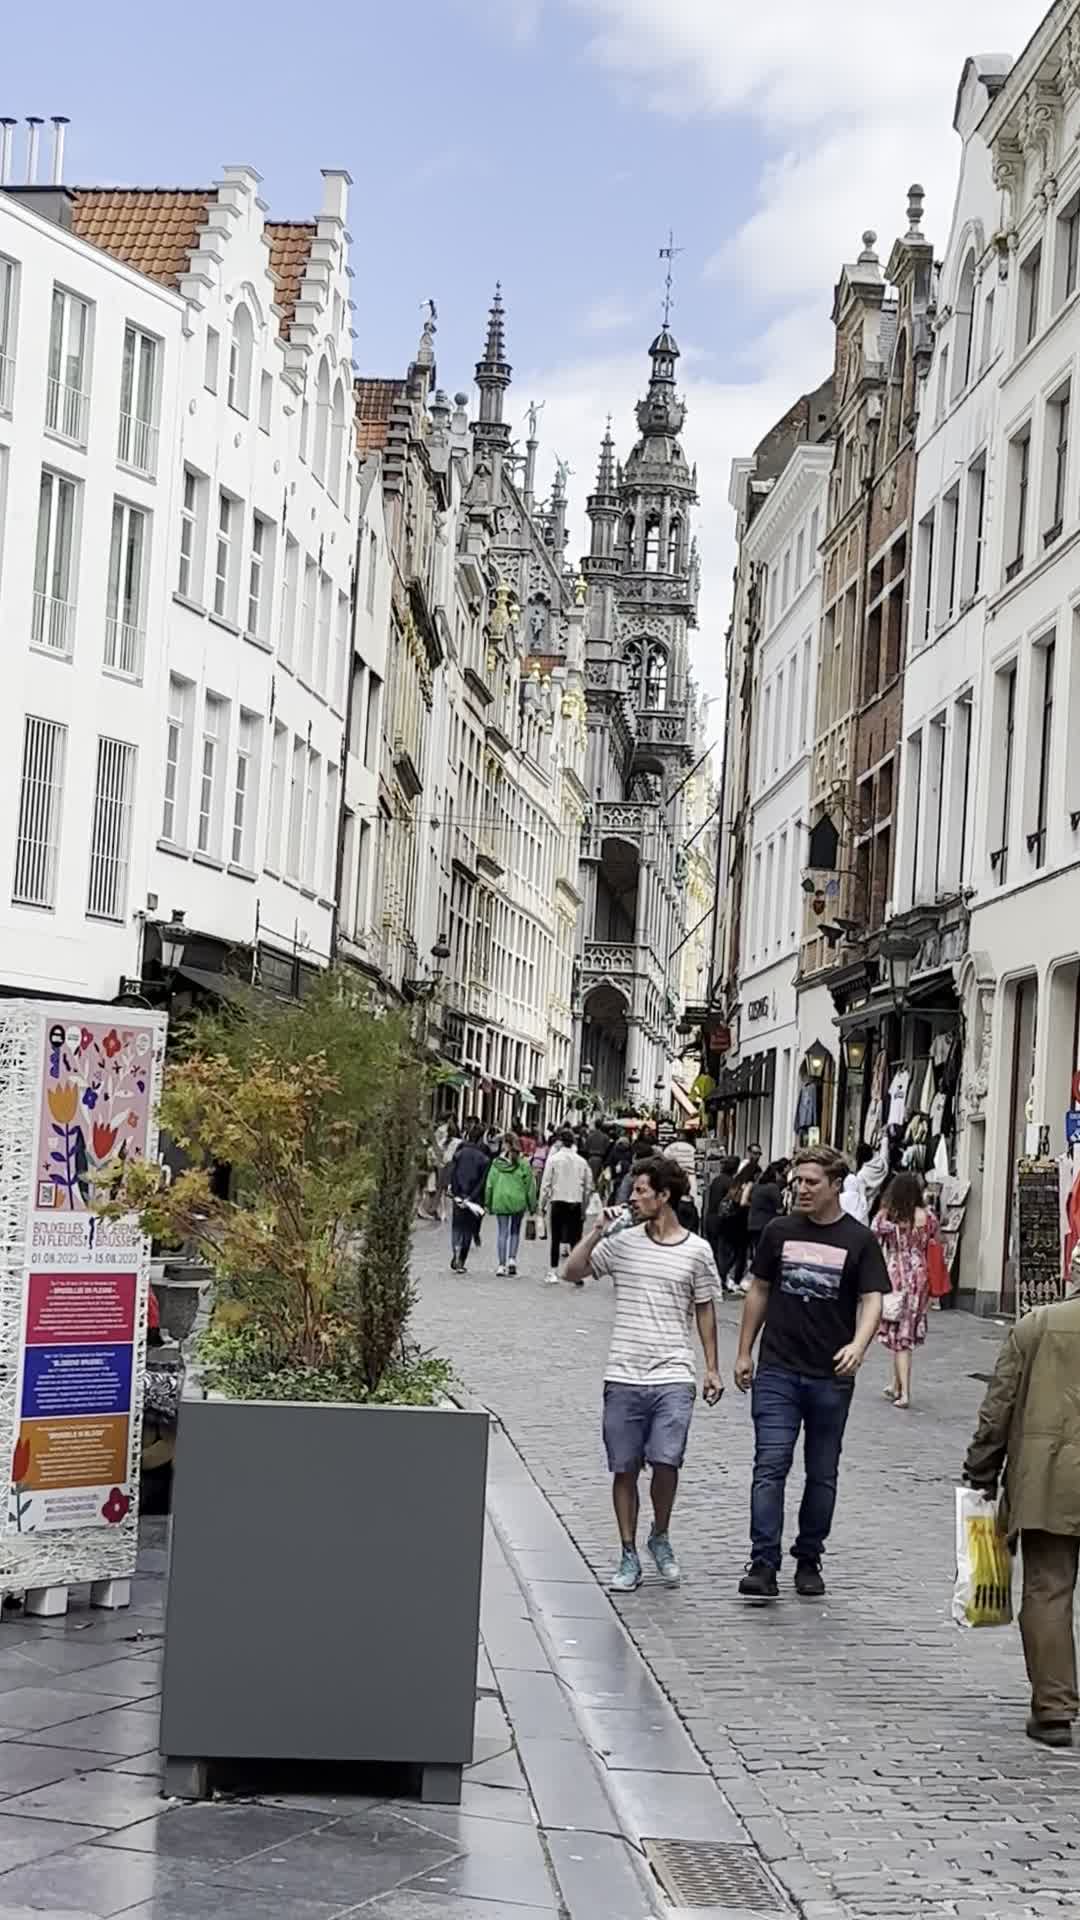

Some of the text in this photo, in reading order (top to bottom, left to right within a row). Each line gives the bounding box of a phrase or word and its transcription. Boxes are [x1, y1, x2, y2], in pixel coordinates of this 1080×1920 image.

[33, 1222, 83, 1234] BRUXELLES
[32, 1234, 46, 1247] EN
[95, 1234, 137, 1247] BRUSSE
